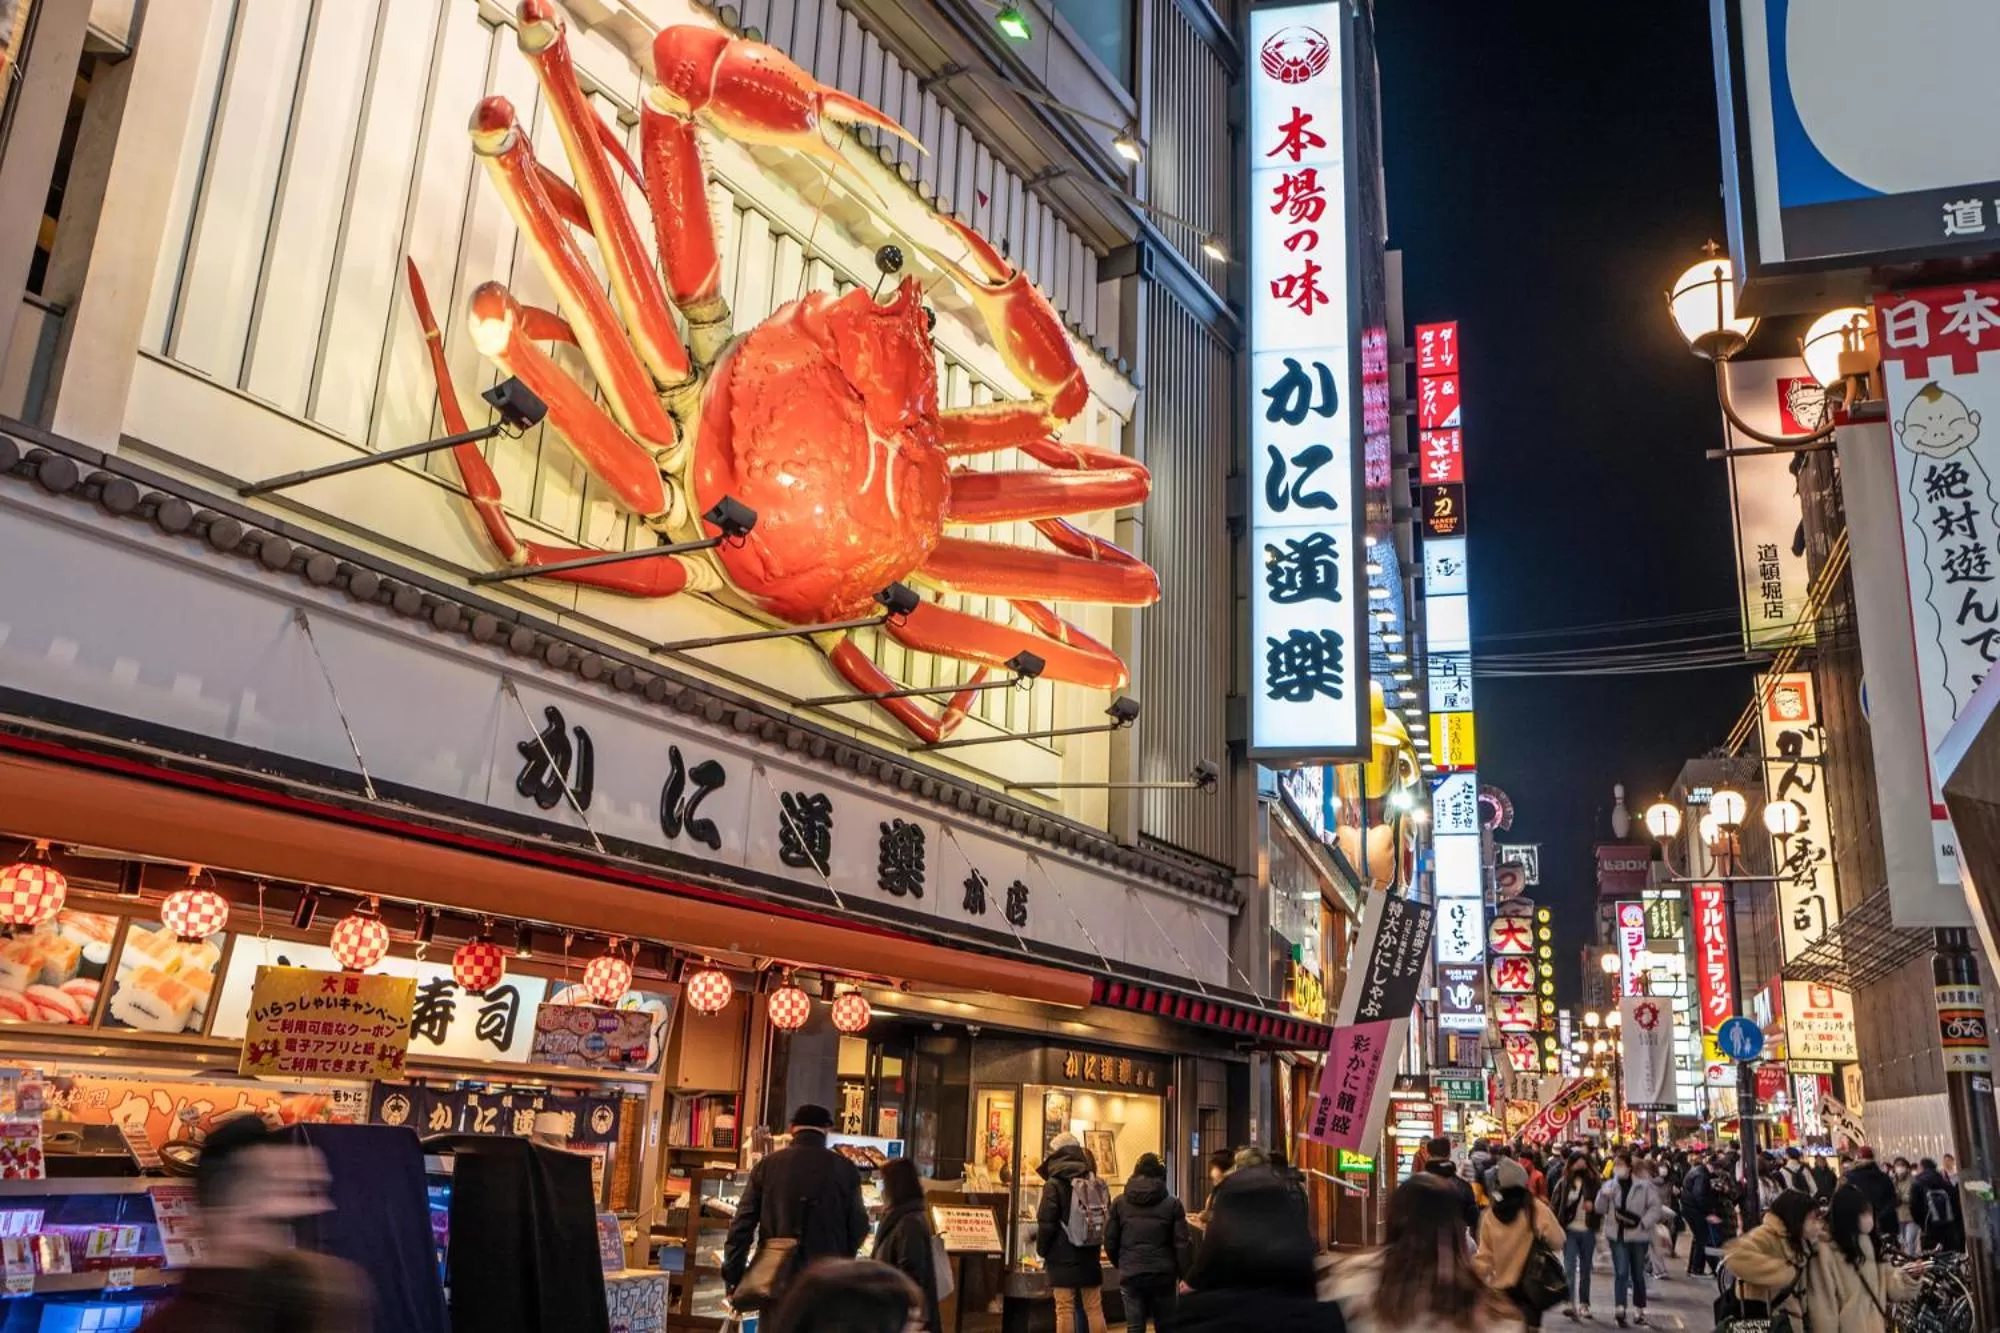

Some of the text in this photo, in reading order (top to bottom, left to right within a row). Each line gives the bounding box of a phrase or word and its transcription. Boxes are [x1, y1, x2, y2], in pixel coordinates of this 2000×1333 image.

[1266, 106, 1329, 316] 本場の味
[1943, 199, 2000, 238] 道
[1882, 289, 2000, 349] 日本
[1757, 544, 1783, 619] 道頓堀店
[1443, 659, 1468, 708] 白木屋
[1361, 901, 1403, 1017] 特大かにしゃぶ
[1701, 890, 1732, 1017] ツルハドラッグ
[321, 976, 360, 995] 大阪
[255, 996, 408, 1030] いらっしゃいキャンペーン
[266, 1019, 396, 1039] ご利用可能なクーポン
[278, 1056, 375, 1074] ご利用できます。
[285, 1038, 377, 1056] 電子アプリと紙
